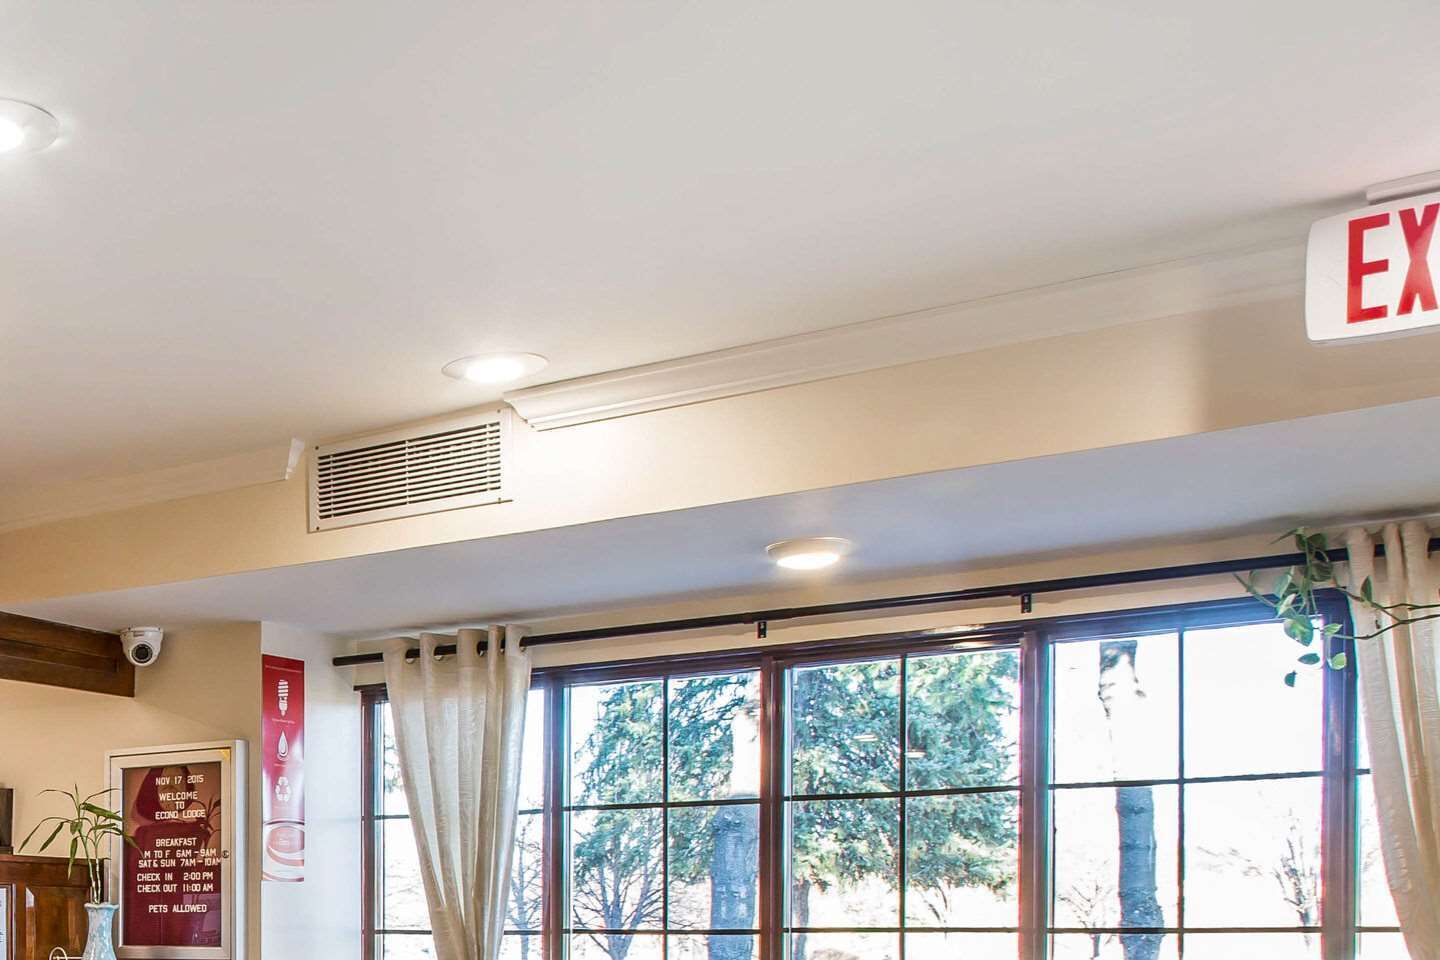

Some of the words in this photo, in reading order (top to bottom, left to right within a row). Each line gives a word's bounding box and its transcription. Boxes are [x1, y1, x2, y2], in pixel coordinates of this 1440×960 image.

[155, 777, 170, 786] NOV
[174, 776, 182, 785] 17
[187, 775, 204, 784] 2015
[159, 791, 198, 801] WELCOME
[175, 801, 185, 810] TO
[155, 811, 178, 820] ECONO
[182, 809, 206, 818] LODGE
[155, 837, 197, 847] BREAKFAST
[144, 850, 151, 859] M
[153, 850, 163, 859] TO
[165, 850, 171, 859] F
[175, 849, 192, 858] 6AM
[199, 848, 217, 857] 9AM
[138, 859, 152, 868] SAT
[160, 859, 176, 868] SUN
[180, 858, 196, 867] 7AM
[204, 857, 221, 866] 10AM
[137, 873, 161, 882] CHECK
[164, 872, 173, 881] IN
[183, 872, 201, 880] 2:00
[202, 872, 213, 880] PM
[137, 884, 161, 893] CHECK
[163, 884, 177, 893] OUT
[183, 883, 201, 892] 11:00
[202, 883, 213, 892] AM
[148, 904, 168, 913] PETS
[172, 904, 207, 913] ALLOWED
